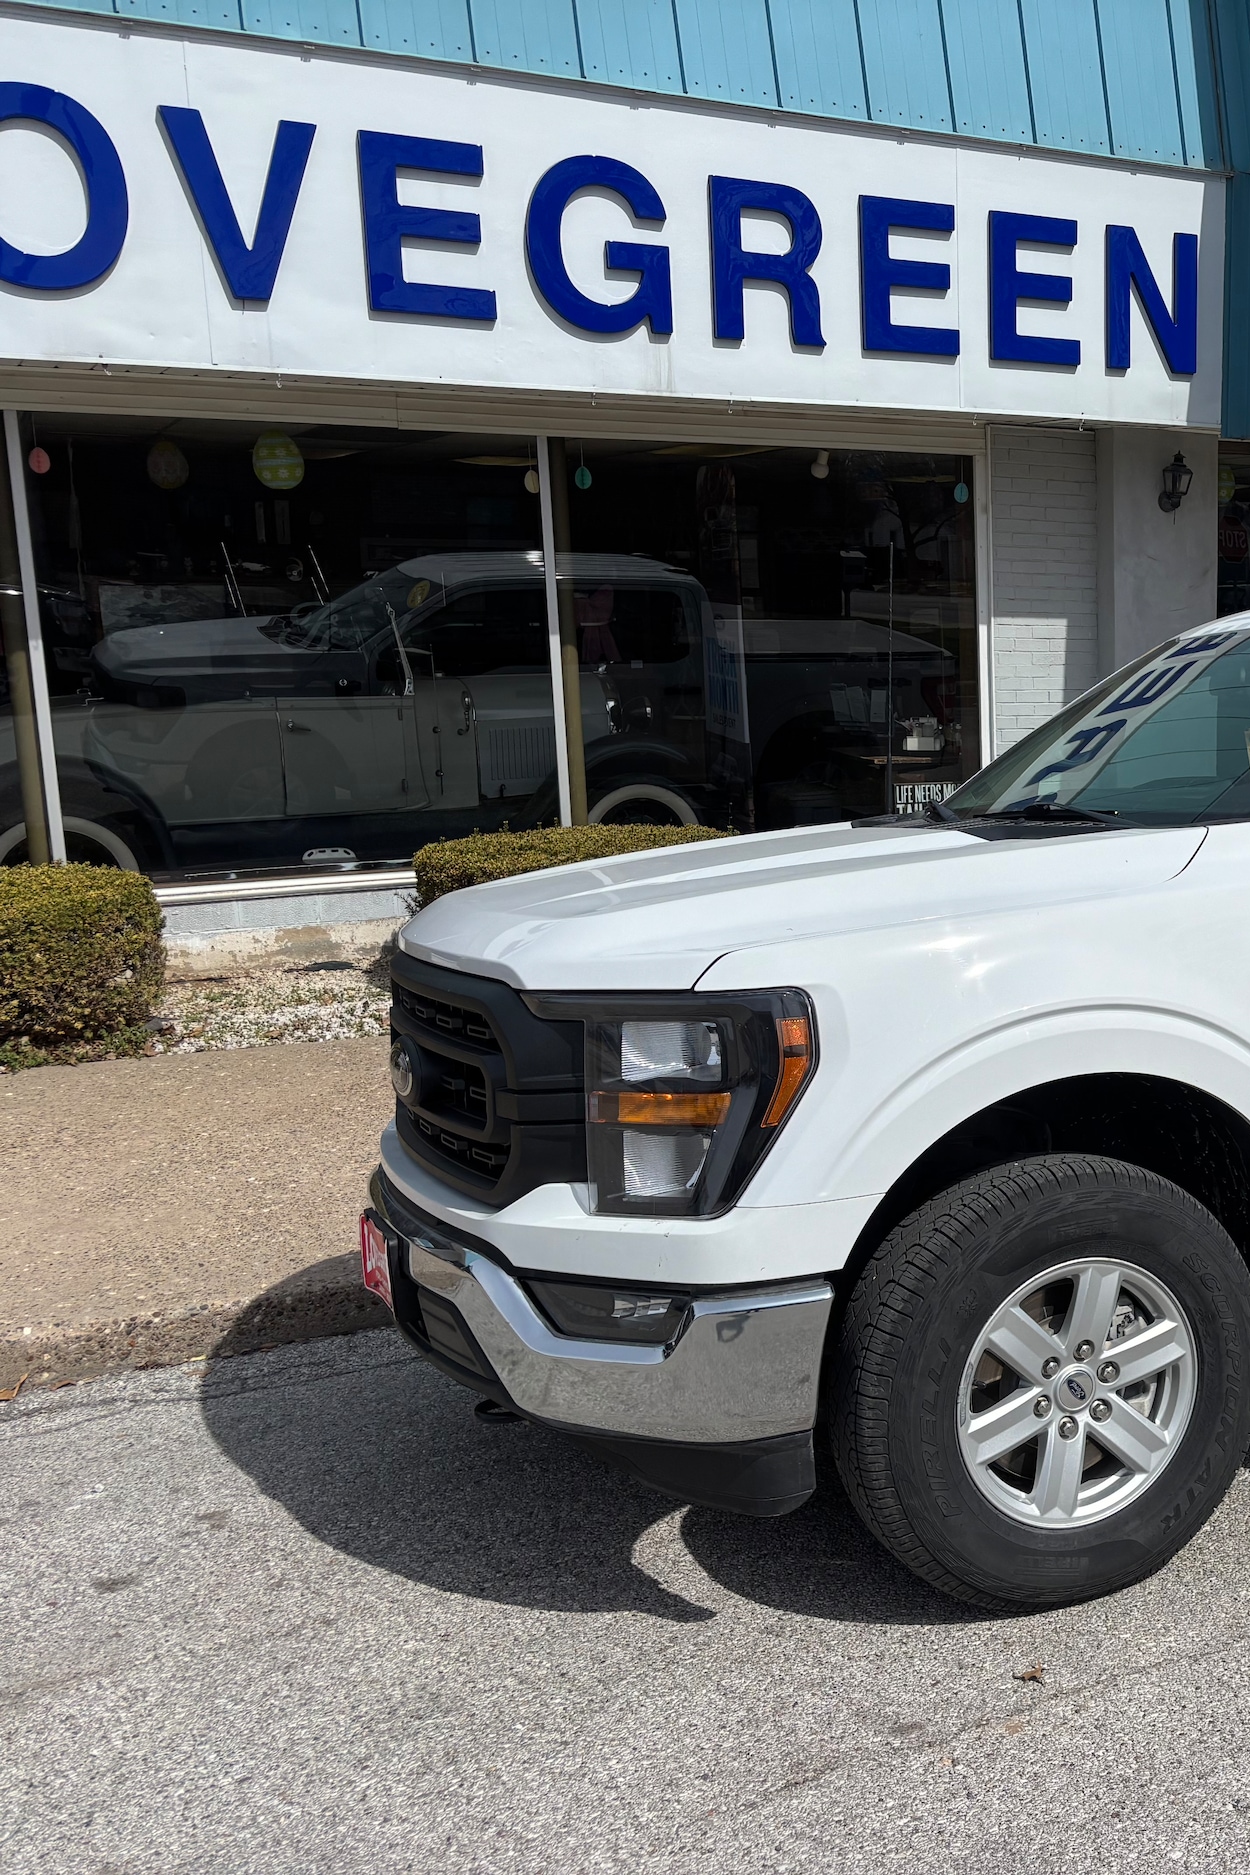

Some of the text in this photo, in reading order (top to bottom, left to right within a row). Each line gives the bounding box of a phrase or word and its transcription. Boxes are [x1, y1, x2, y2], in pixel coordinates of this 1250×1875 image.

[0, 82, 1198, 376] OVEGREEN
[708, 675, 740, 715] MONTH
[896, 785, 914, 804] LIFE
[914, 784, 942, 803] NEEDS
[920, 1336, 964, 1519] PIRELLI
[1181, 1251, 1245, 1455] SCORPION
